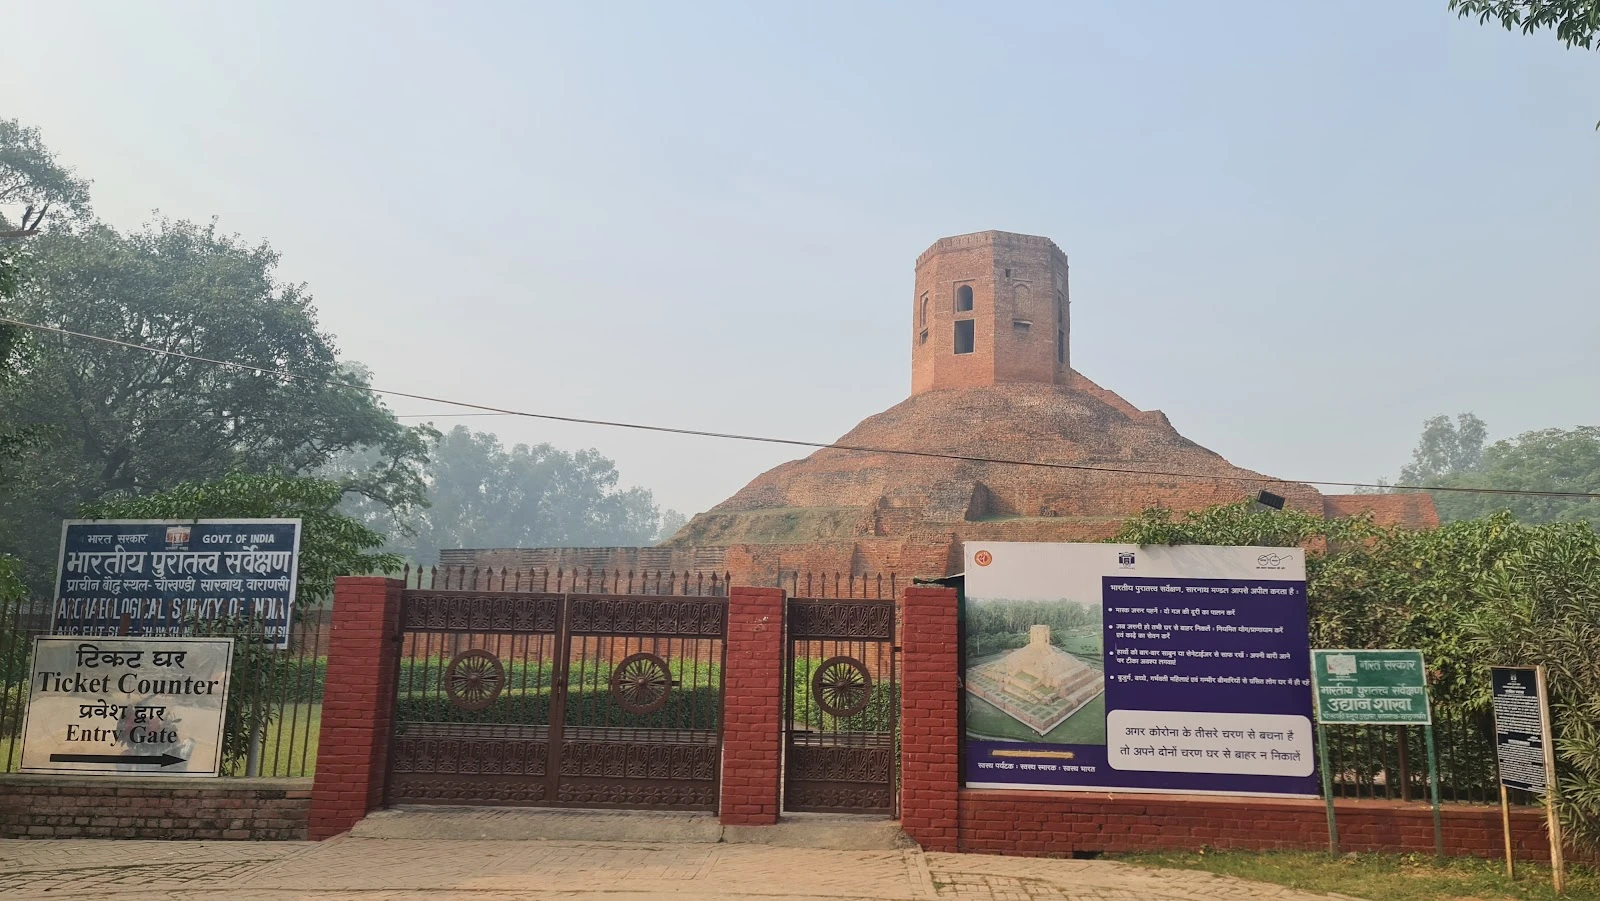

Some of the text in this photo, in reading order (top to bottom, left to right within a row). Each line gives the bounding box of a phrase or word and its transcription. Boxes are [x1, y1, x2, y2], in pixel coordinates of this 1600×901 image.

[88, 534, 148, 544] भारत सरकार
[202, 534, 275, 544] GOVT. OF INDIA
[67, 545, 291, 578] भारतीय पुरातत्त्व सर्वेक्षण
[66, 576, 101, 592] प्राचीन
[154, 576, 196, 592] चौखण्डी
[201, 578, 244, 594] सारनाथ,
[246, 576, 290, 592] वाराणसी
[1110, 583, 1133, 591] भारतीय
[1185, 586, 1209, 594] सारनाथ
[1231, 586, 1248, 594] आपसे
[1251, 586, 1268, 595] अपील
[1289, 587, 1294, 595] है
[252, 598, 286, 620] NDIA
[1191, 608, 1200, 616] दूरी
[1274, 626, 1283, 634] करें
[76, 644, 187, 668] टिकट घर
[1358, 660, 1416, 670] भारत सरकार
[38, 672, 219, 695] Ticket Counter
[1320, 683, 1354, 696] भारतीय
[1392, 683, 1423, 696] सर्वेक्षण
[79, 699, 166, 724] प्रवेश द्वार
[1327, 698, 1412, 712] उद्यान शाखा
[66, 724, 177, 747] Entry Gate
[1126, 726, 1294, 741] अगर कोरोना के तीसरे चरण से बचना है
[1120, 744, 1301, 762] तो अपने दोनों चरण घर से बाहर न निकालें
